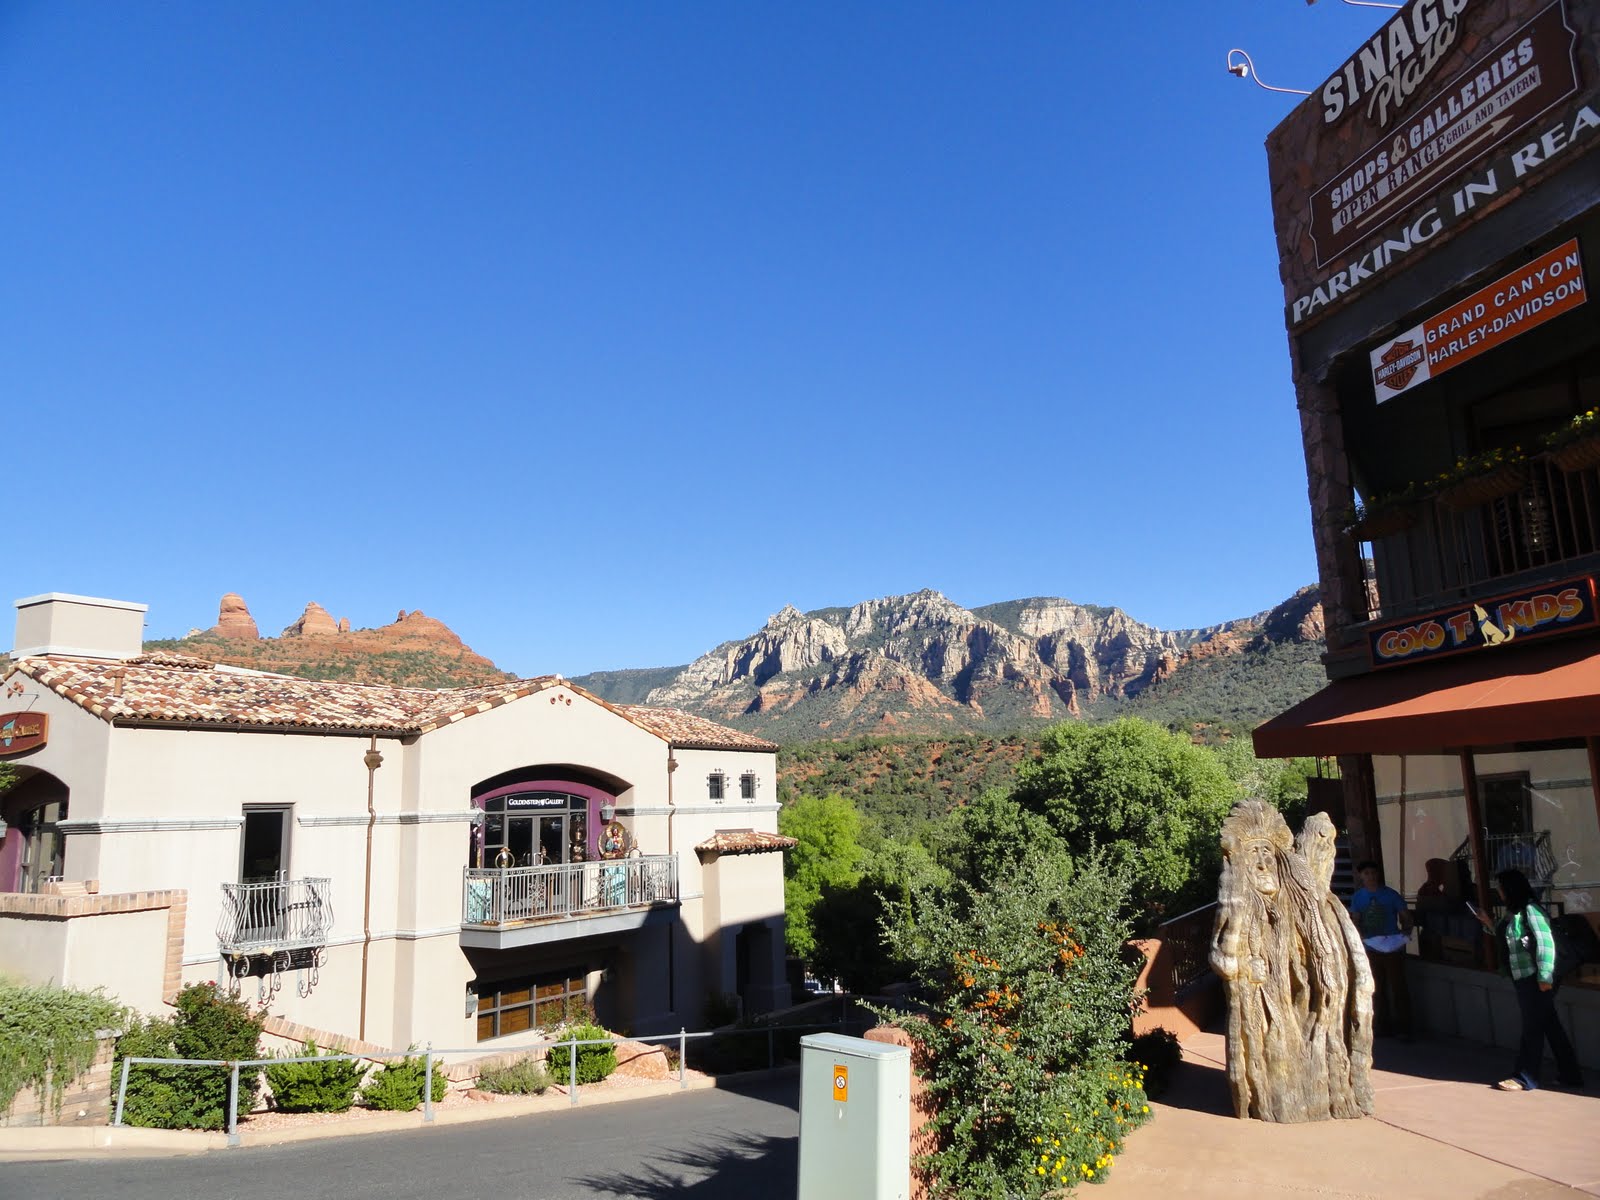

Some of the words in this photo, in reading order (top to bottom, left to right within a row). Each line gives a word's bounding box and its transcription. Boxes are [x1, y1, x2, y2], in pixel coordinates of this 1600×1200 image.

[1331, 151, 1388, 209] SHOPS
[1390, 136, 1407, 166] &
[1409, 38, 1534, 150] GALLERIES
[1367, 14, 1458, 128] Plaza
[1339, 183, 1379, 227] OPEN
[1387, 134, 1447, 194] RANGE
[1446, 121, 1472, 147] GRILL
[1475, 102, 1494, 125] AND
[1497, 70, 1538, 109] TAVERN
[1292, 208, 1443, 324] PARKING
[1453, 169, 1498, 216] IN
[1426, 303, 1485, 344] GRAND
[1494, 252, 1579, 307] CANYON
[1429, 276, 1582, 365] HARLEY-DAVIDSON
[1377, 620, 1446, 658] COYO
[1498, 588, 1583, 631] KIDS
